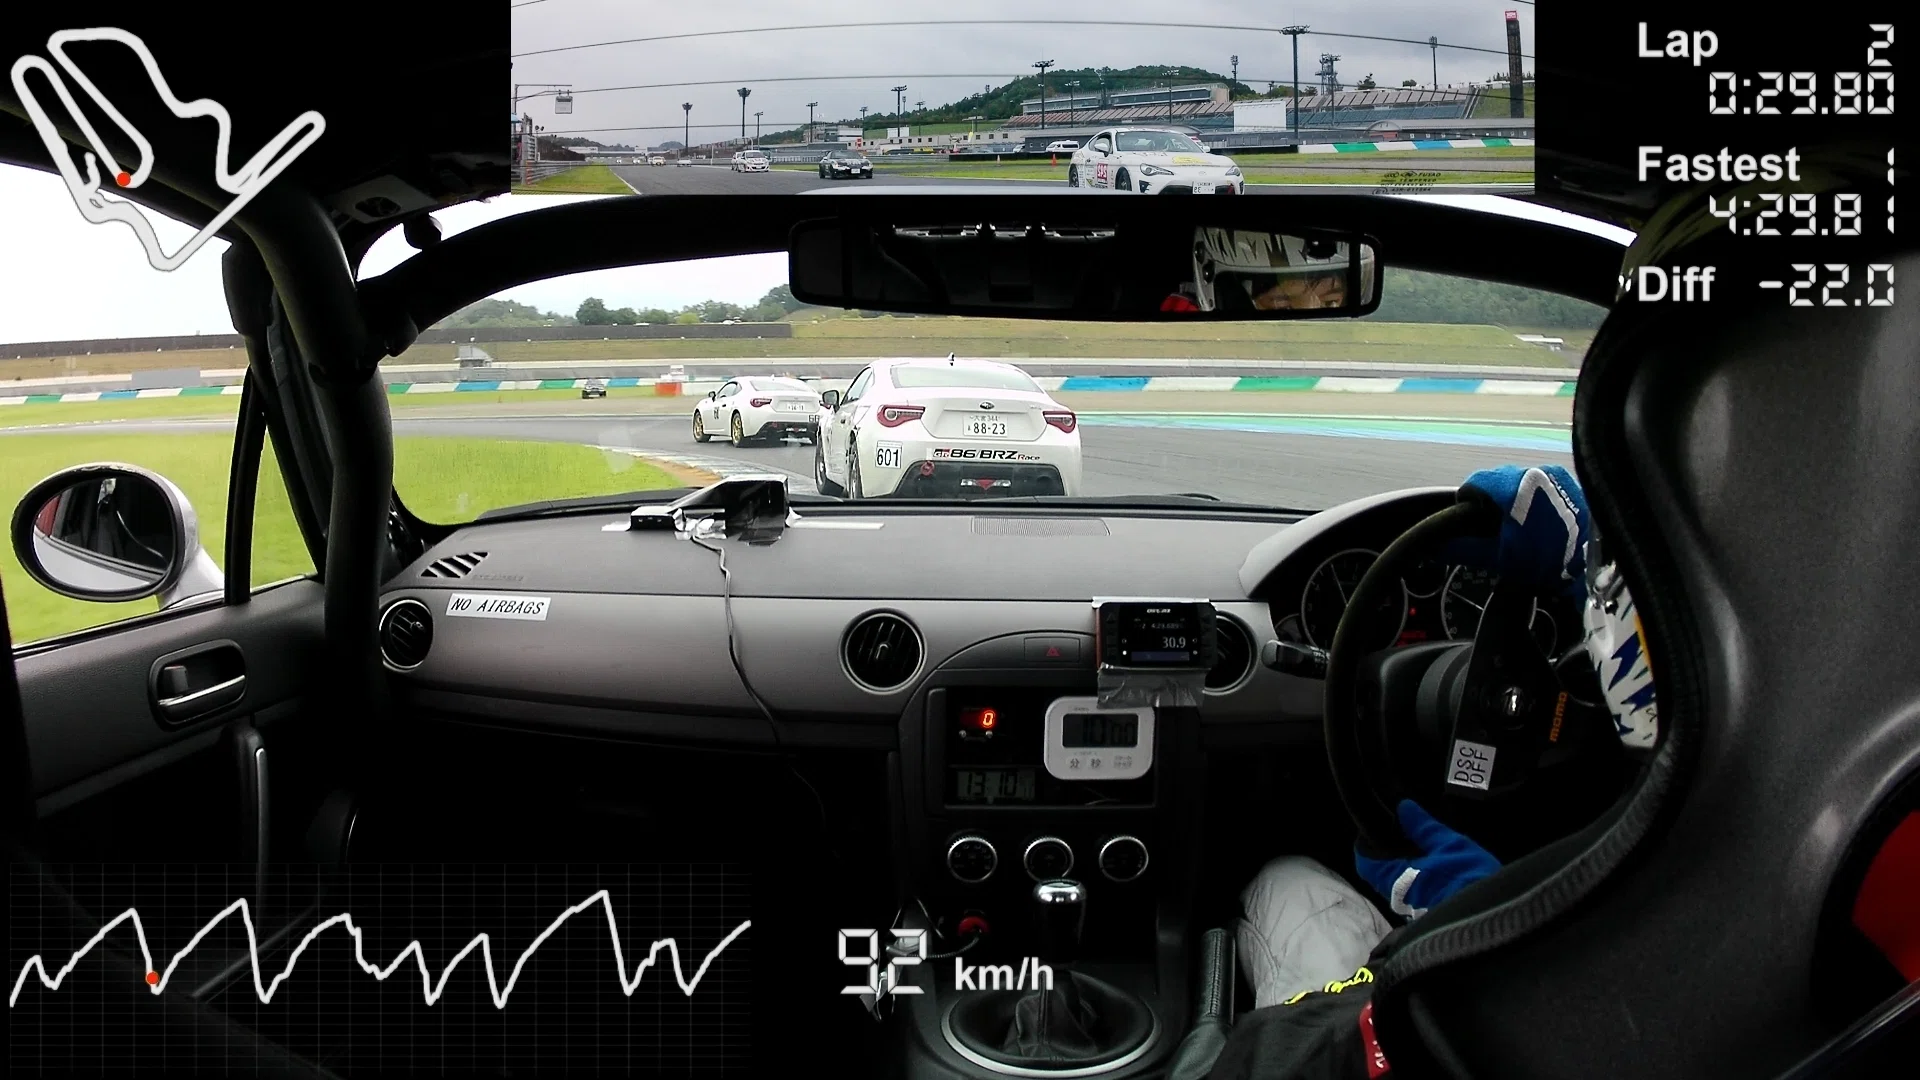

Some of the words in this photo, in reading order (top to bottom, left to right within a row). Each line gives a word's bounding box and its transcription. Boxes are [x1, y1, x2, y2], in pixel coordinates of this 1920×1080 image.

[973, 422, 1006, 435] 88-23
[876, 448, 899, 467] 601
[450, 598, 472, 611] NO
[477, 599, 545, 615] AIRBAGS
[1162, 636, 1187, 650] 30.9
[1453, 746, 1475, 783] DSC
[1469, 749, 1489, 785] OFF
